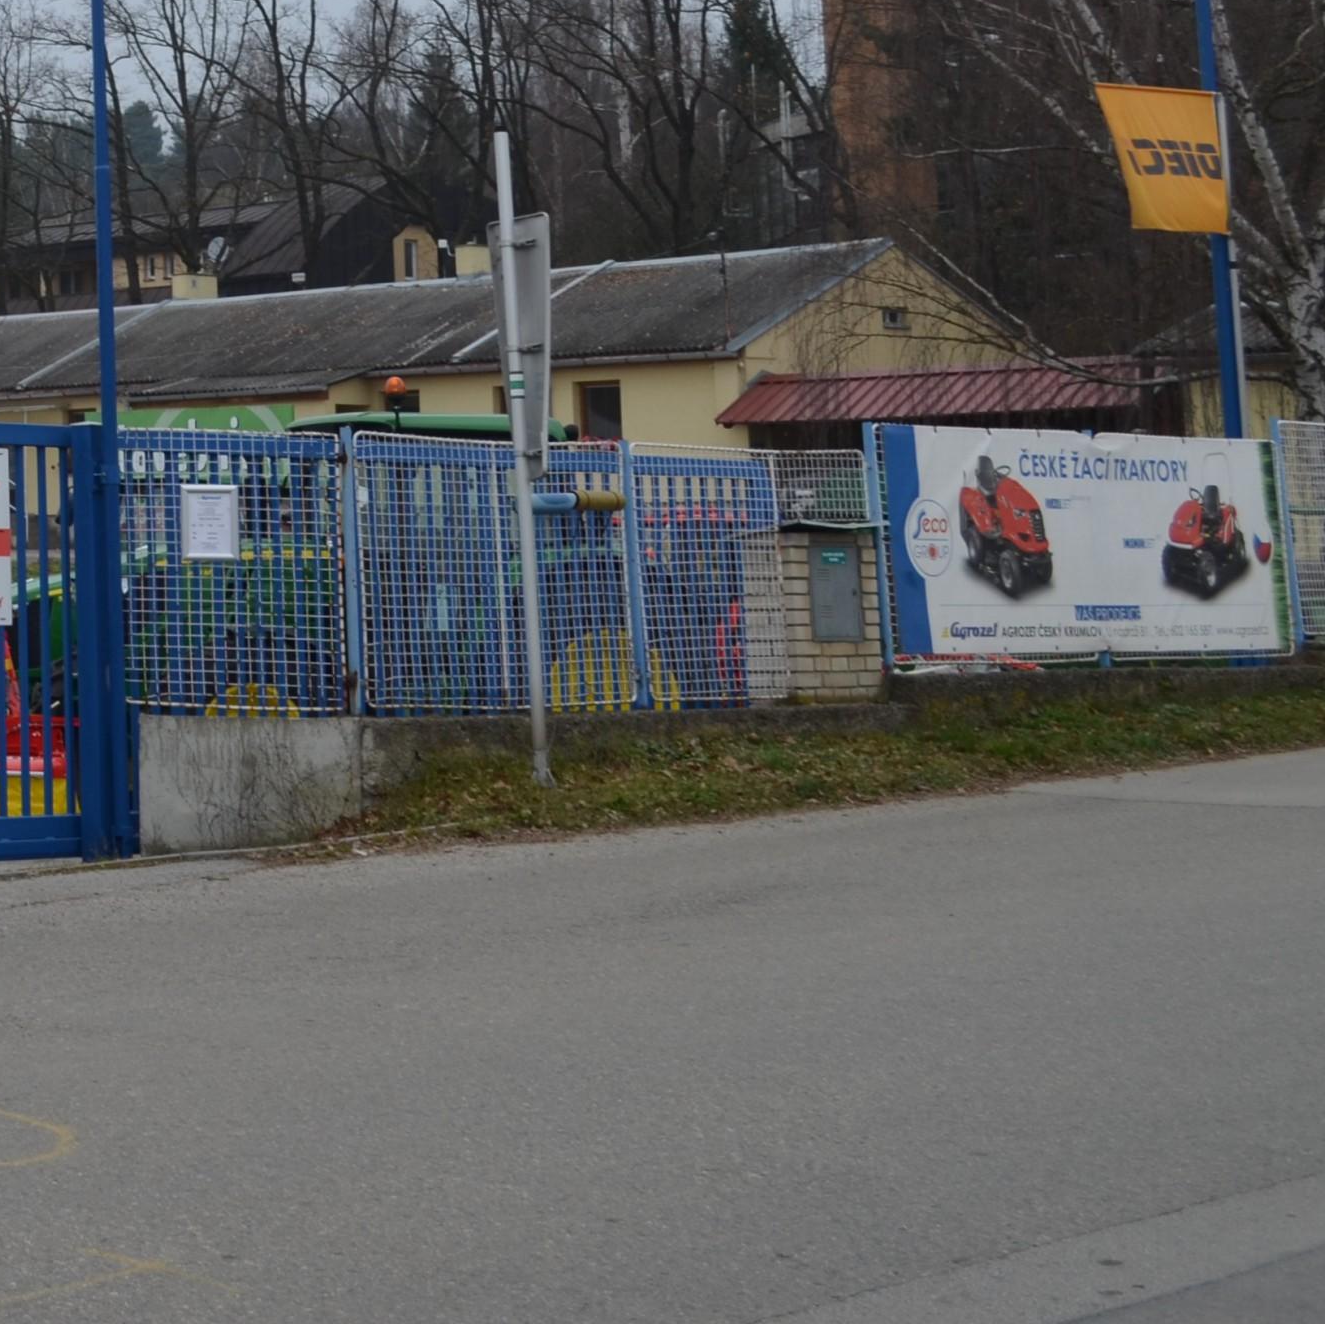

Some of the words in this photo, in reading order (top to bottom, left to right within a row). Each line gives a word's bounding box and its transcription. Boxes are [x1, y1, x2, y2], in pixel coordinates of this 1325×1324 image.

[1018, 448, 1068, 479] ČESKÉ
[1070, 451, 1112, 480] ŽACÍ
[1113, 458, 1188, 482] TRAKTORY
[950, 621, 998, 640] Agrozet
